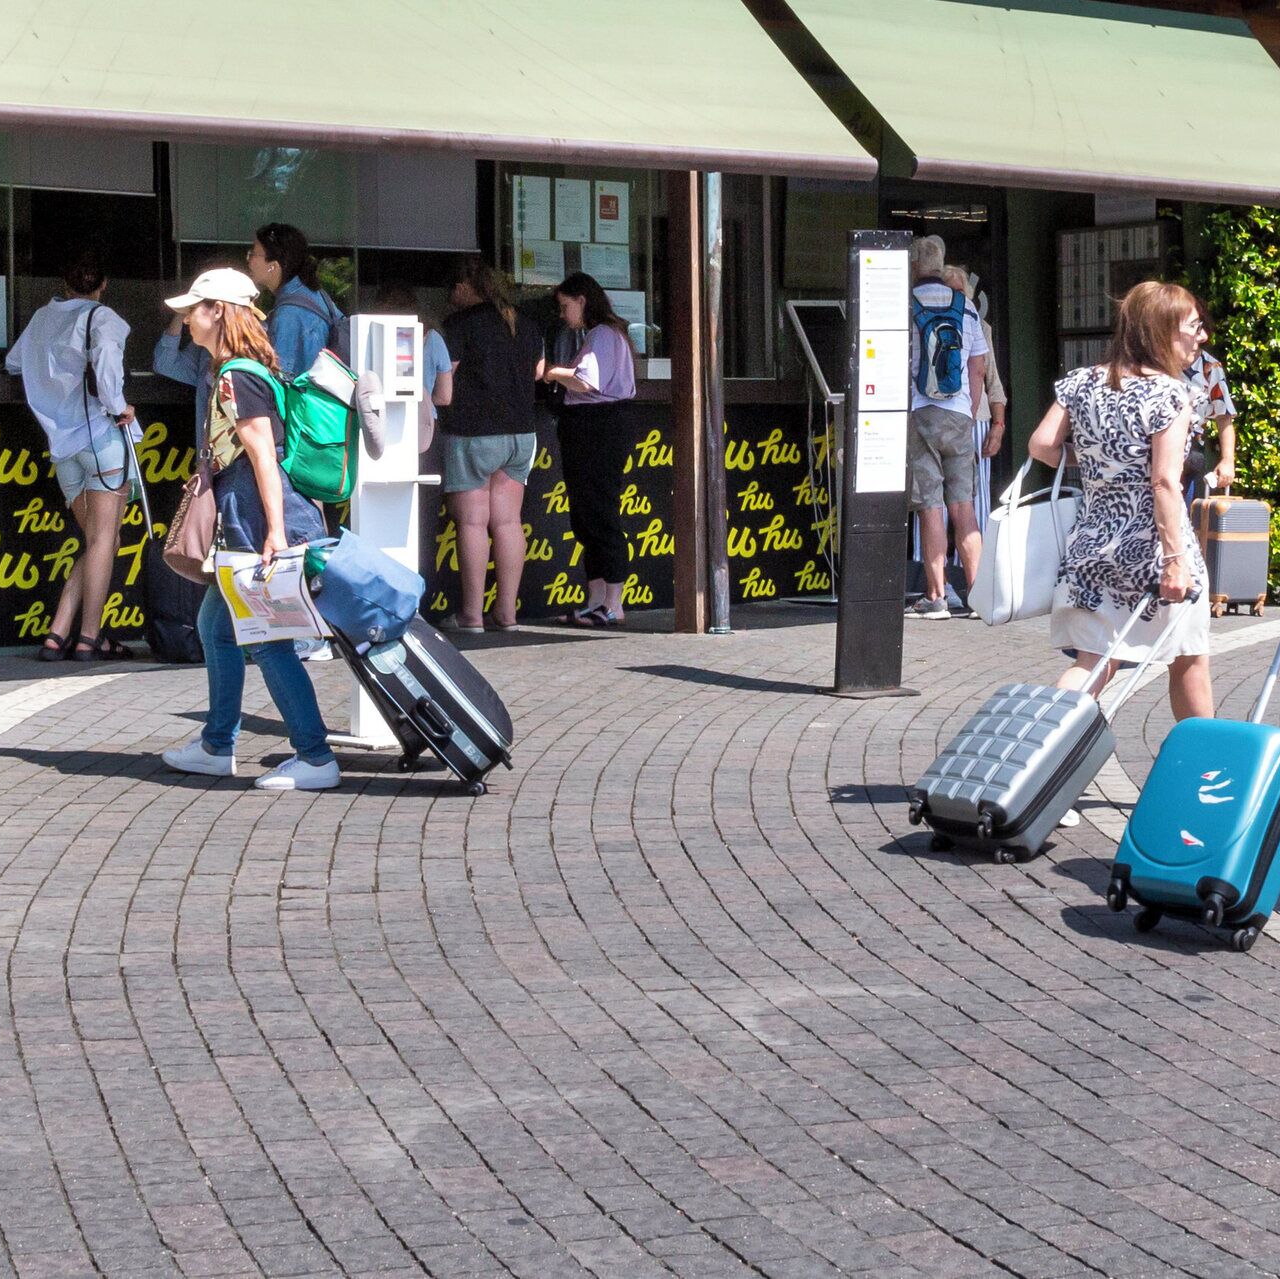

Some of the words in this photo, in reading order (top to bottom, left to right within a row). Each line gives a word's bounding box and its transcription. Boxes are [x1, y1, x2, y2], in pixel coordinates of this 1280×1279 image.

[135, 423, 196, 483] hu
[724, 440, 755, 471] u
[757, 428, 800, 465] hu
[619, 484, 652, 515] hu
[737, 481, 774, 511] hu
[792, 475, 828, 505] hu
[13, 497, 65, 533] hu
[727, 527, 757, 558] u
[758, 514, 803, 551] hu
[543, 572, 586, 606] hu
[620, 573, 654, 605] hu
[738, 567, 776, 598] hu
[794, 560, 830, 591] hu
[100, 592, 145, 628] hu
